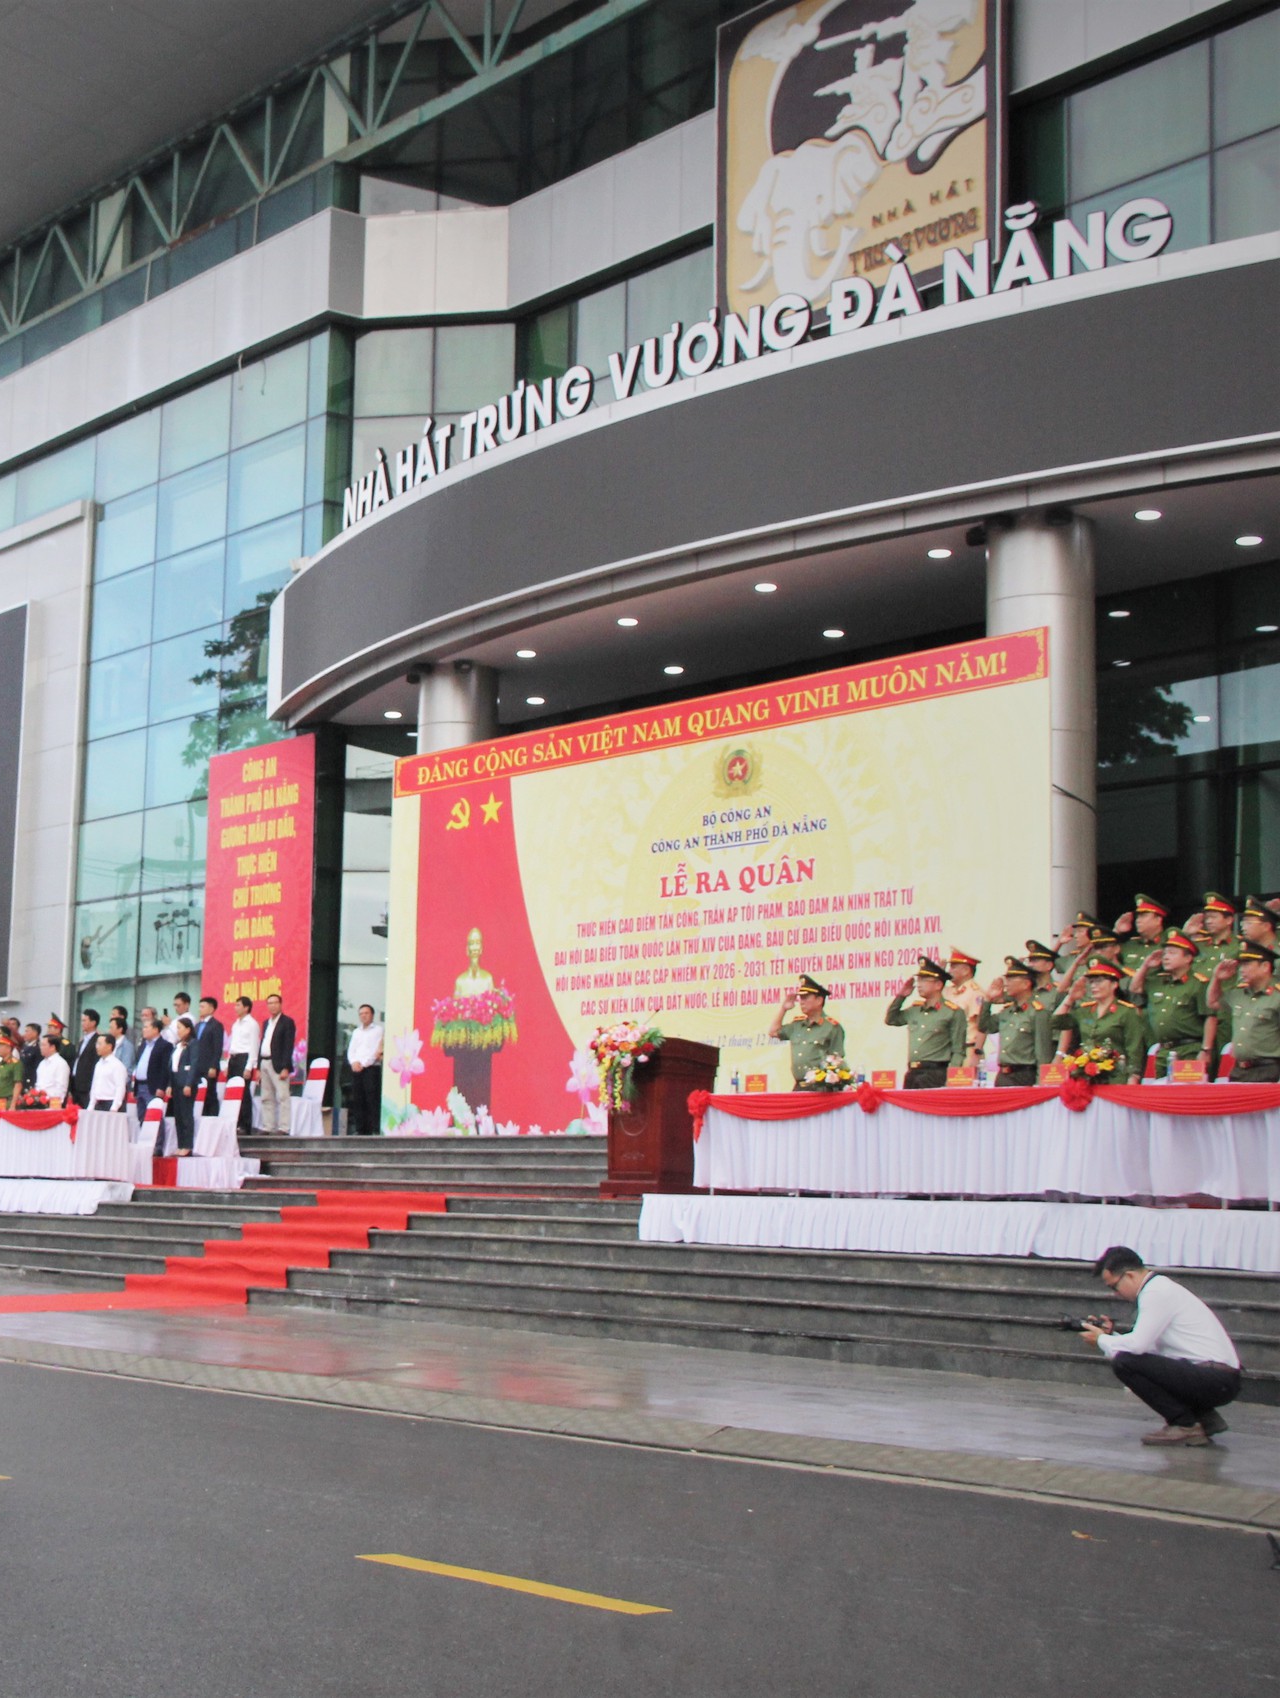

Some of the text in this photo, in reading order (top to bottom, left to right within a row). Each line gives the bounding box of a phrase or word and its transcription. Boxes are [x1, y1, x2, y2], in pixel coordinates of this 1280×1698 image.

[871, 178, 974, 229] NHÀ HÁT
[342, 198, 1173, 530] NHÀ HÁT TRƯNG VƯƠNG ĐÀ NẴNG
[417, 651, 1008, 786] ĐẢNG CỘNG SẢN VIỆT NAM QUANG VINH MUÔN NĂM!
[651, 814, 827, 854] CÔNG AN THÀNH PHỐ ĐÀ NẴNG
[702, 805, 772, 829] BỘ CÔNG AN
[660, 855, 816, 898] LỄ RA QUÂN
